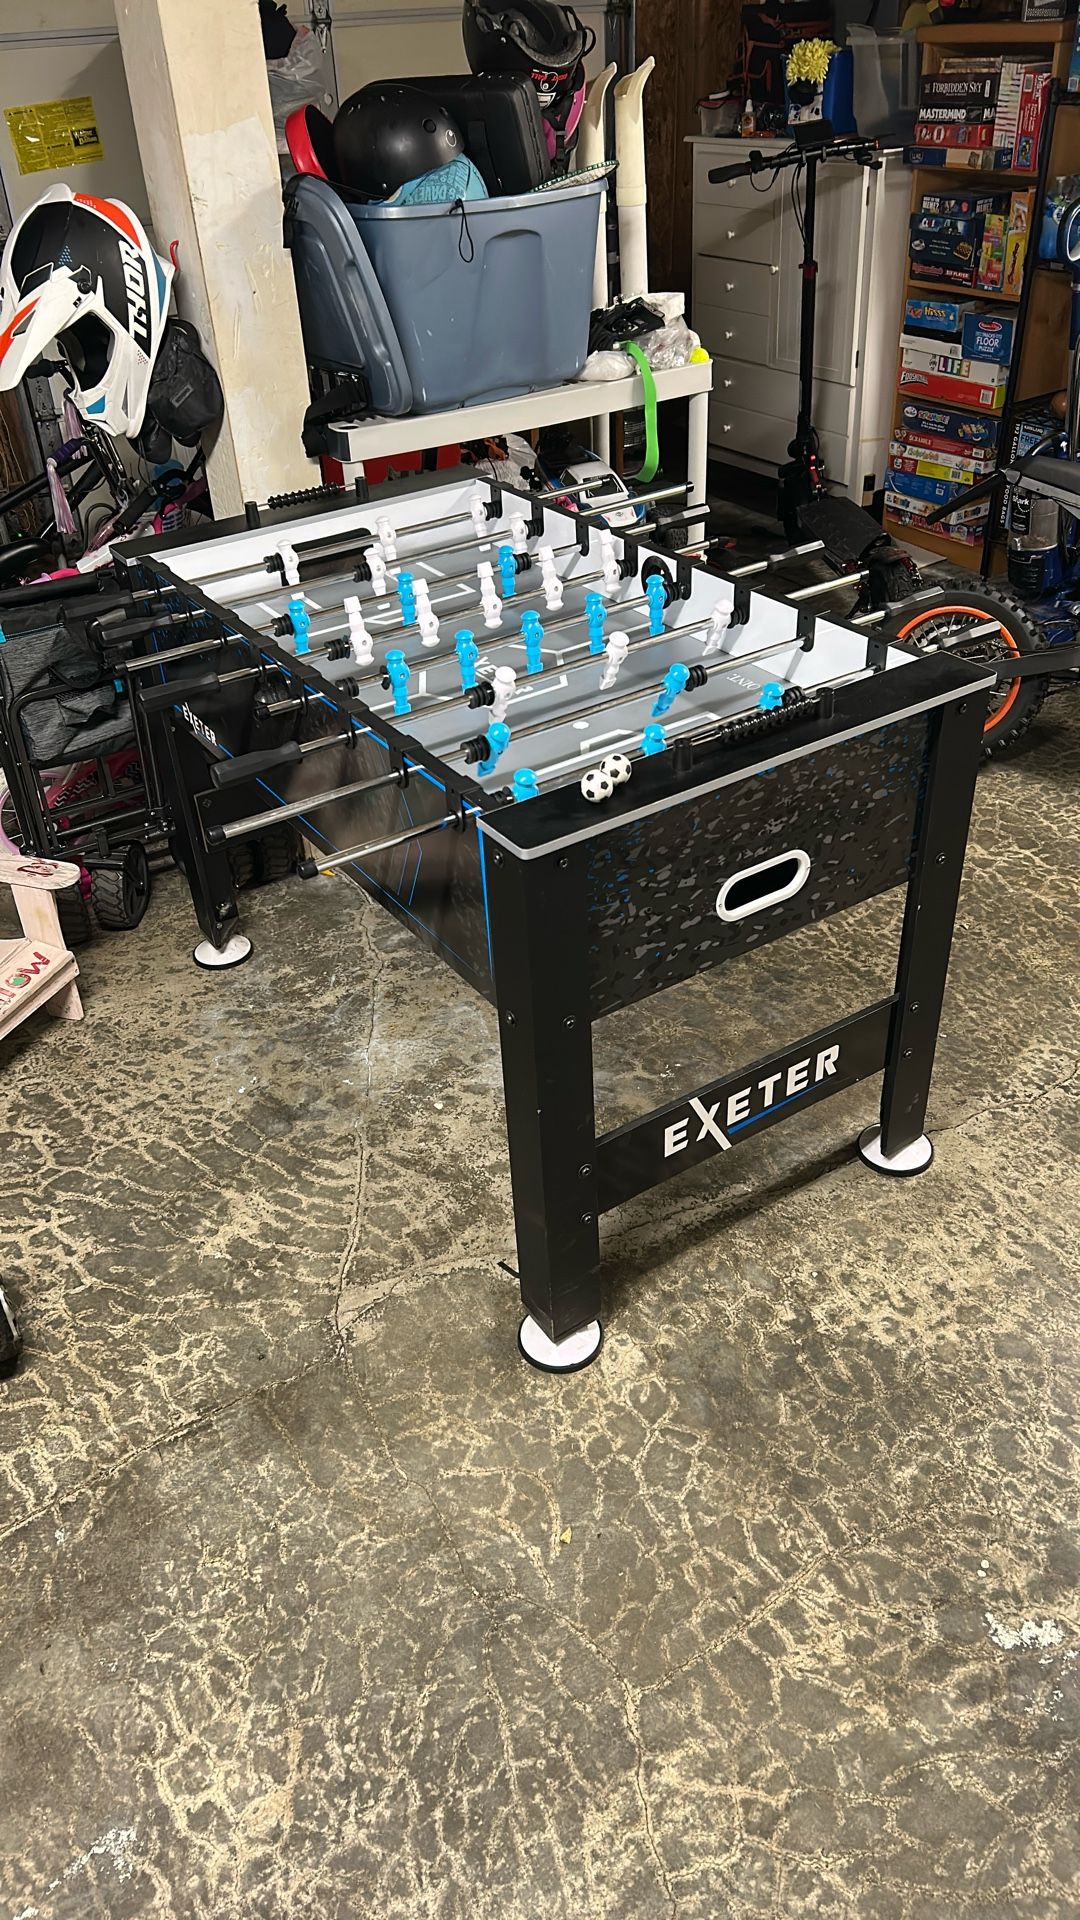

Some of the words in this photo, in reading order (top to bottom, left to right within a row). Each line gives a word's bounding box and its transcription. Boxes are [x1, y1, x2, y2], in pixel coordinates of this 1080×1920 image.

[932, 82, 968, 94] FORBIDDEN
[969, 82, 982, 93] SKY
[919, 108, 967, 121] MASTERMIND
[118, 239, 148, 341] THOR
[976, 337, 1000, 348] FLOOR
[939, 356, 970, 378] LIFE
[181, 701, 218, 747] EXETER
[664, 1044, 840, 1158] EXETER
